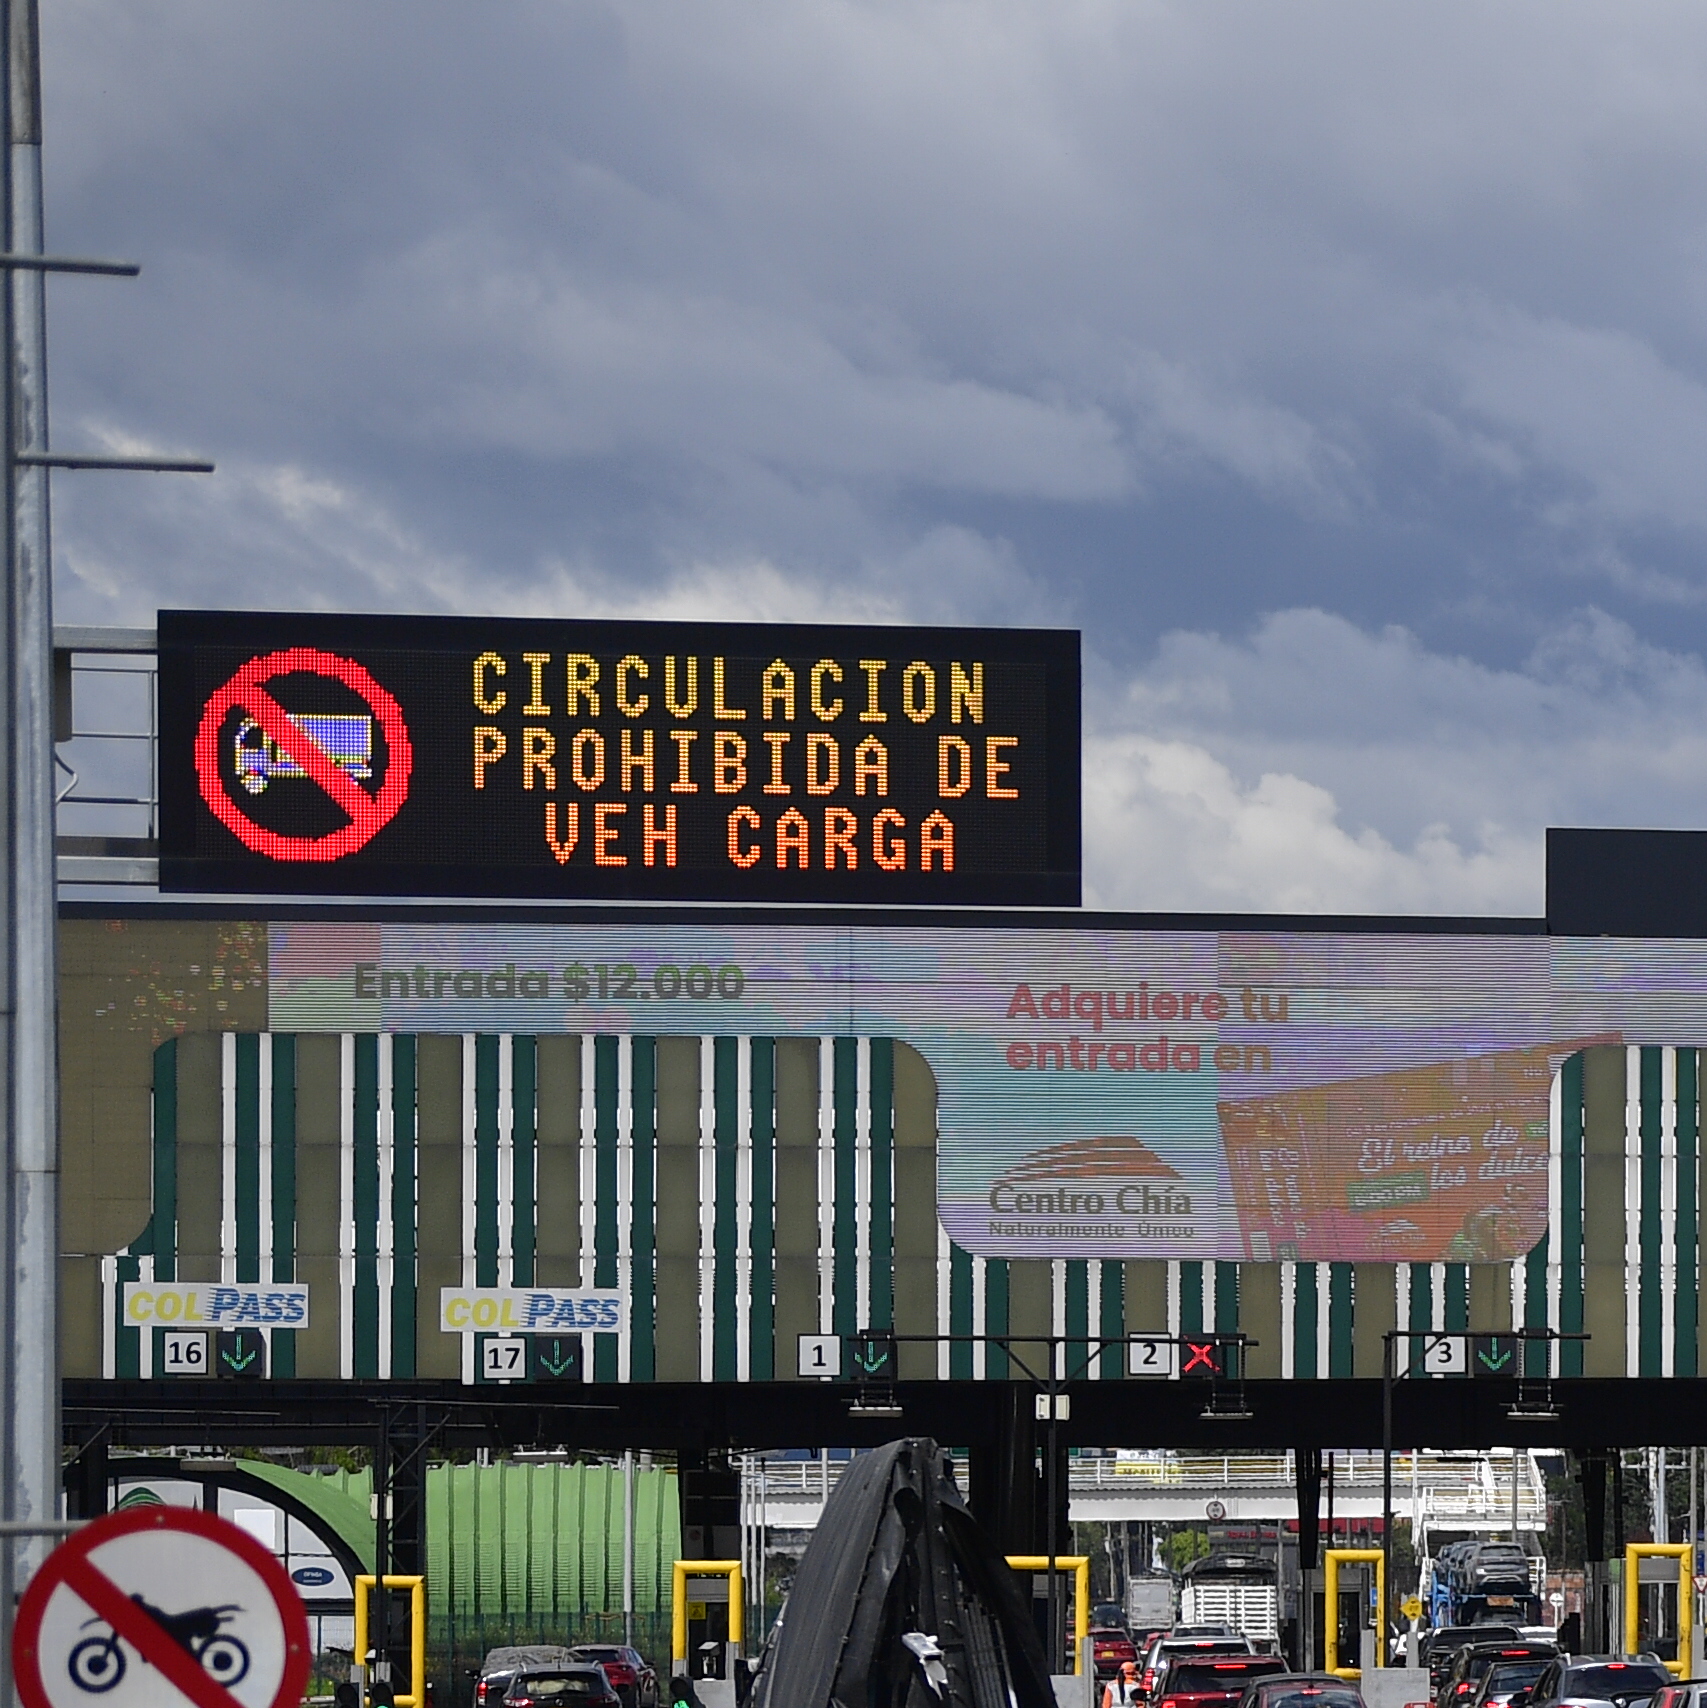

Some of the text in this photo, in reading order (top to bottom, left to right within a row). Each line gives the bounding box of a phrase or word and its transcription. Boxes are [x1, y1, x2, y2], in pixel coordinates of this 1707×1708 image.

[472, 651, 984, 724] CIRCULACION
[473, 726, 1019, 800] PROHIBIDA DE
[545, 802, 956, 873] VEH CARGA
[353, 961, 746, 1001] Entrada $12.000
[1005, 982, 1289, 1031] Adquiere tu
[1005, 1036, 1272, 1071] entrada en
[989, 1184, 1193, 1214] Centro Chía
[989, 1221, 1125, 1237] Naturalmente
[168, 1341, 201, 1366] 16
[487, 1346, 521, 1371] 17
[811, 1344, 827, 1367] 1
[1143, 1343, 1157, 1365] 2
[1437, 1342, 1452, 1365] 3
